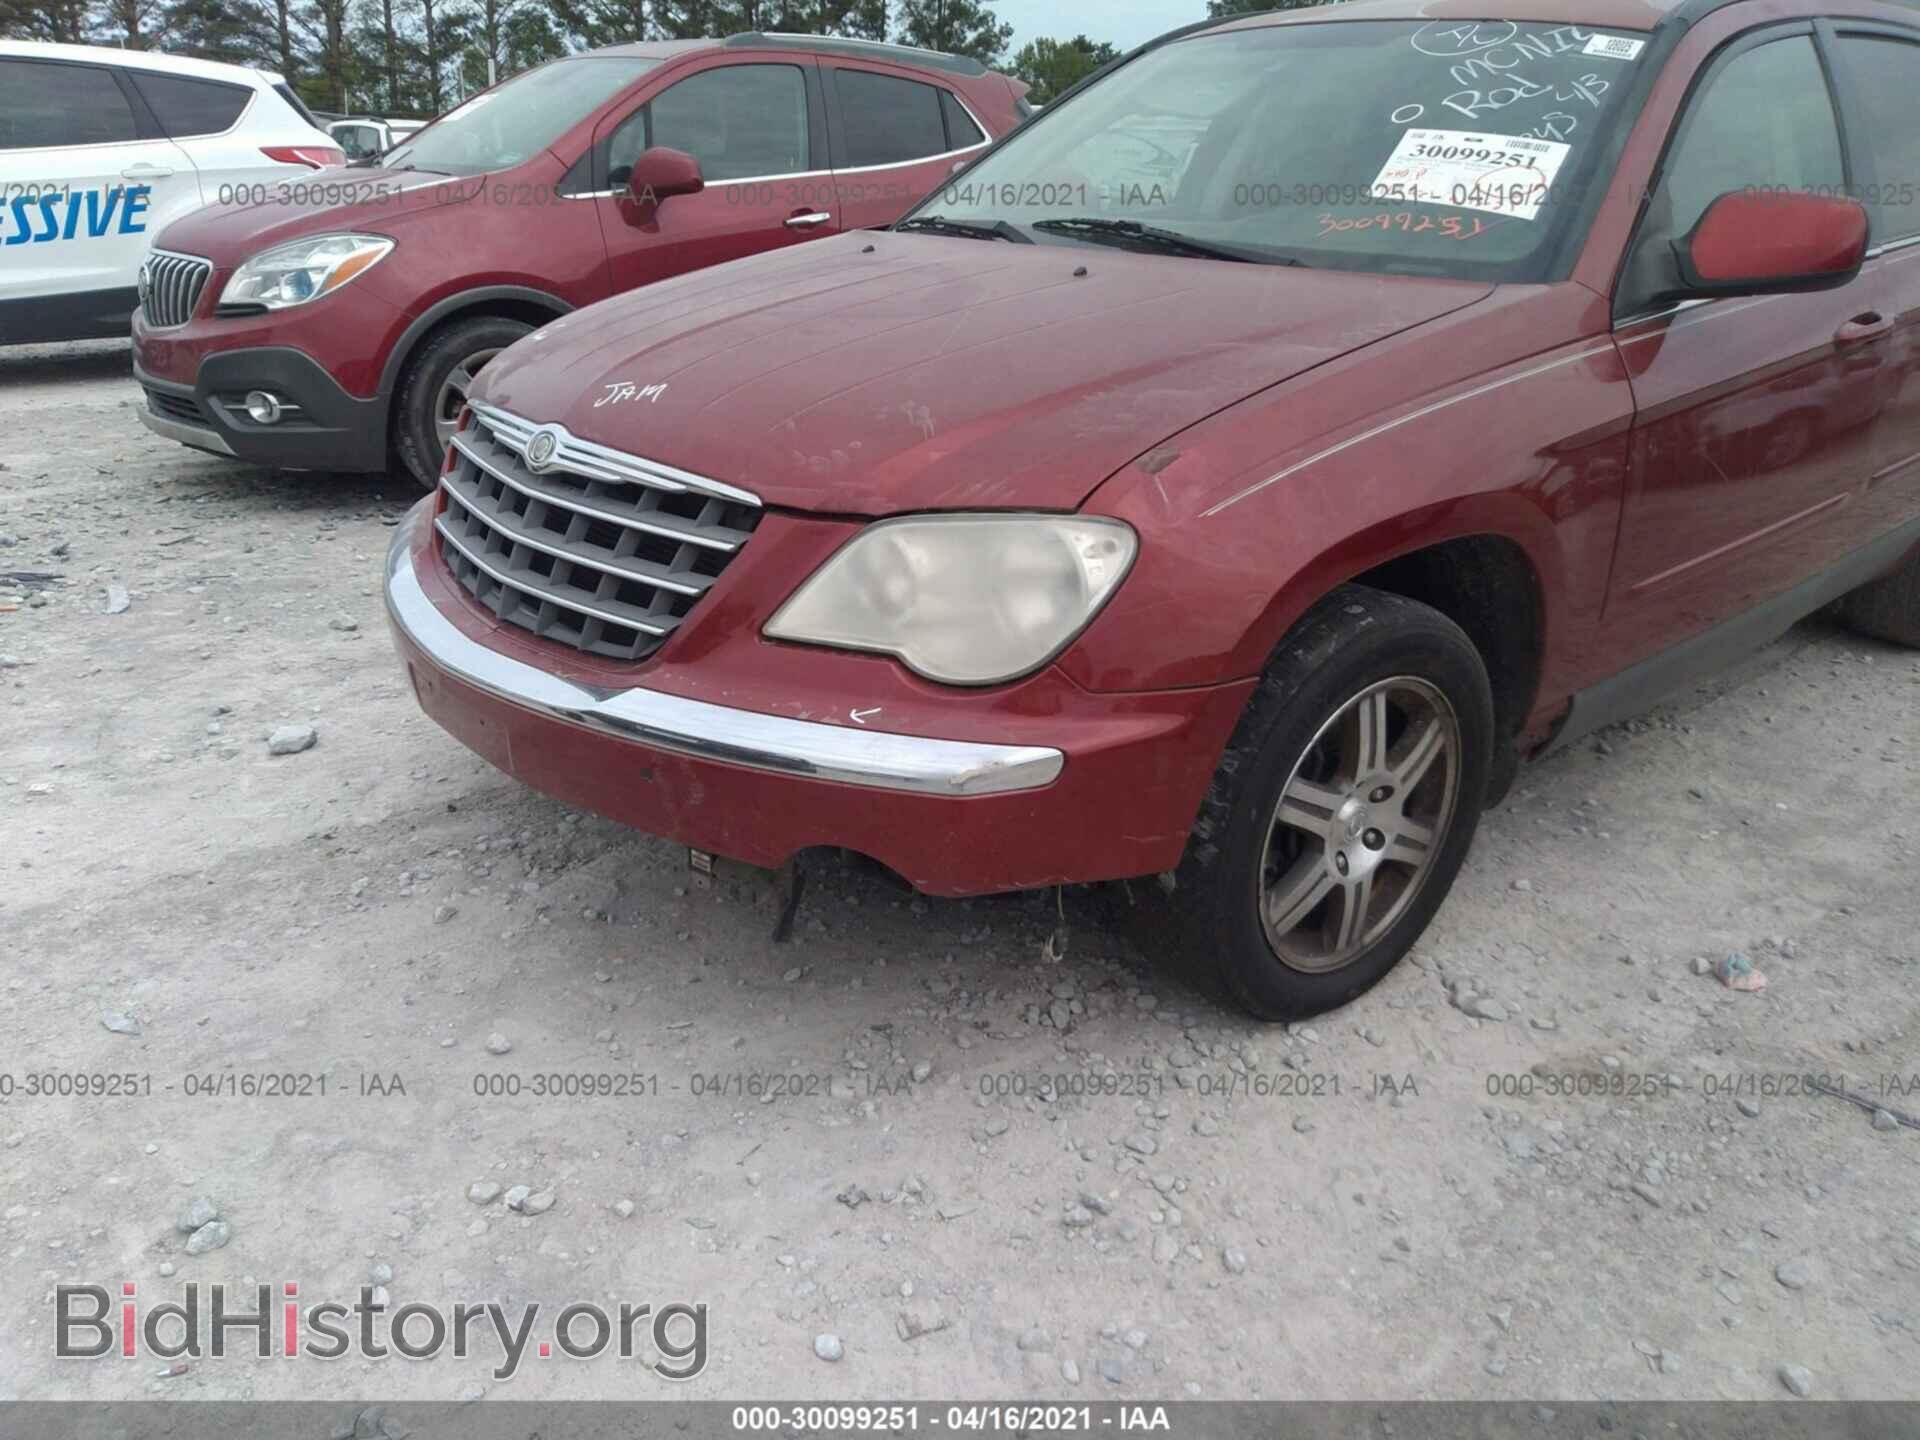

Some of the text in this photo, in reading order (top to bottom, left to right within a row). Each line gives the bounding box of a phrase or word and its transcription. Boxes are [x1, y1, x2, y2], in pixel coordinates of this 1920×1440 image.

[1409, 143, 1538, 170] 30099251
[0, 173, 152, 246] SSIVE
[593, 380, 668, 408] JAM
